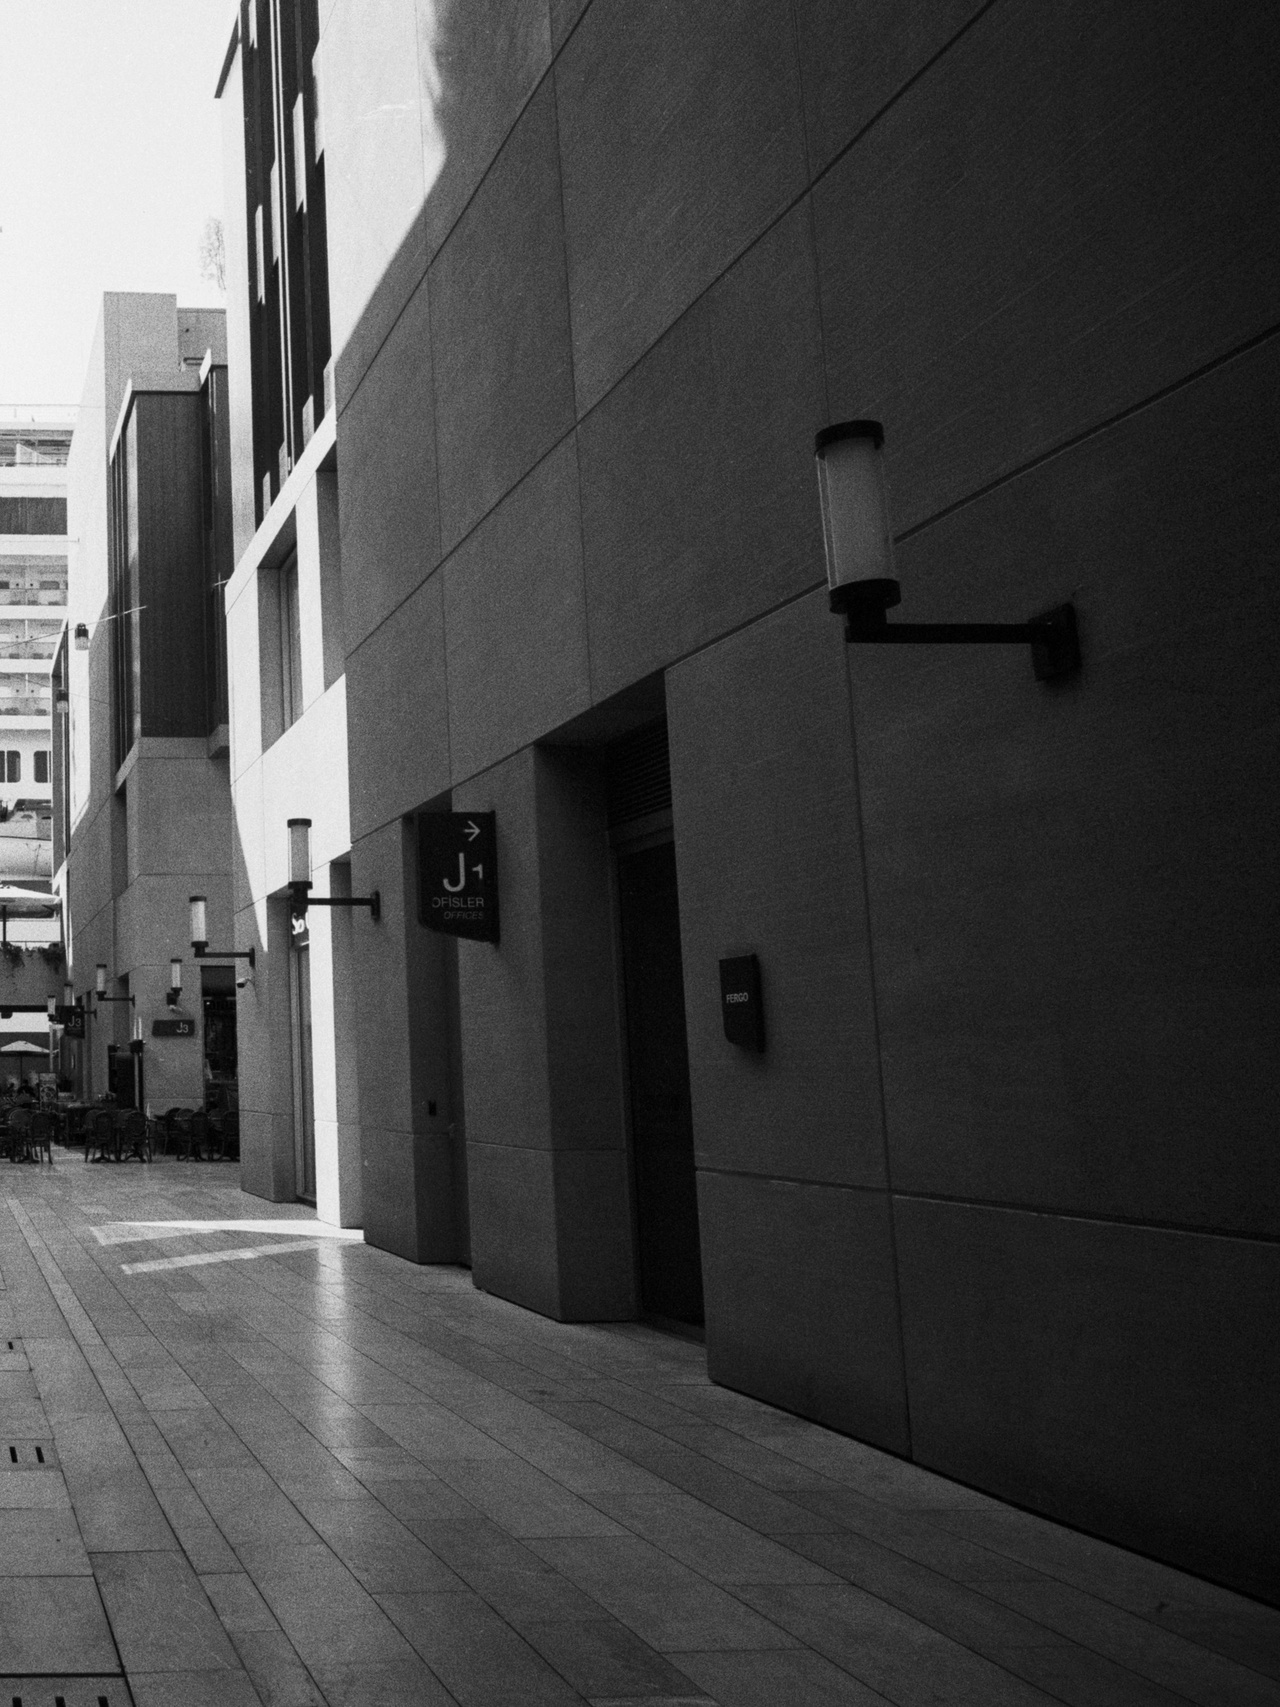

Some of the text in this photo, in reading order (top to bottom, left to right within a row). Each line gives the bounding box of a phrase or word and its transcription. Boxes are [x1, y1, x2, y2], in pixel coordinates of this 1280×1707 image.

[442, 852, 483, 892] J1
[443, 911, 484, 920] OFFICES
[726, 992, 749, 1004] FERGO
[68, 1015, 81, 1027] J3
[176, 1021, 189, 1034] J3
